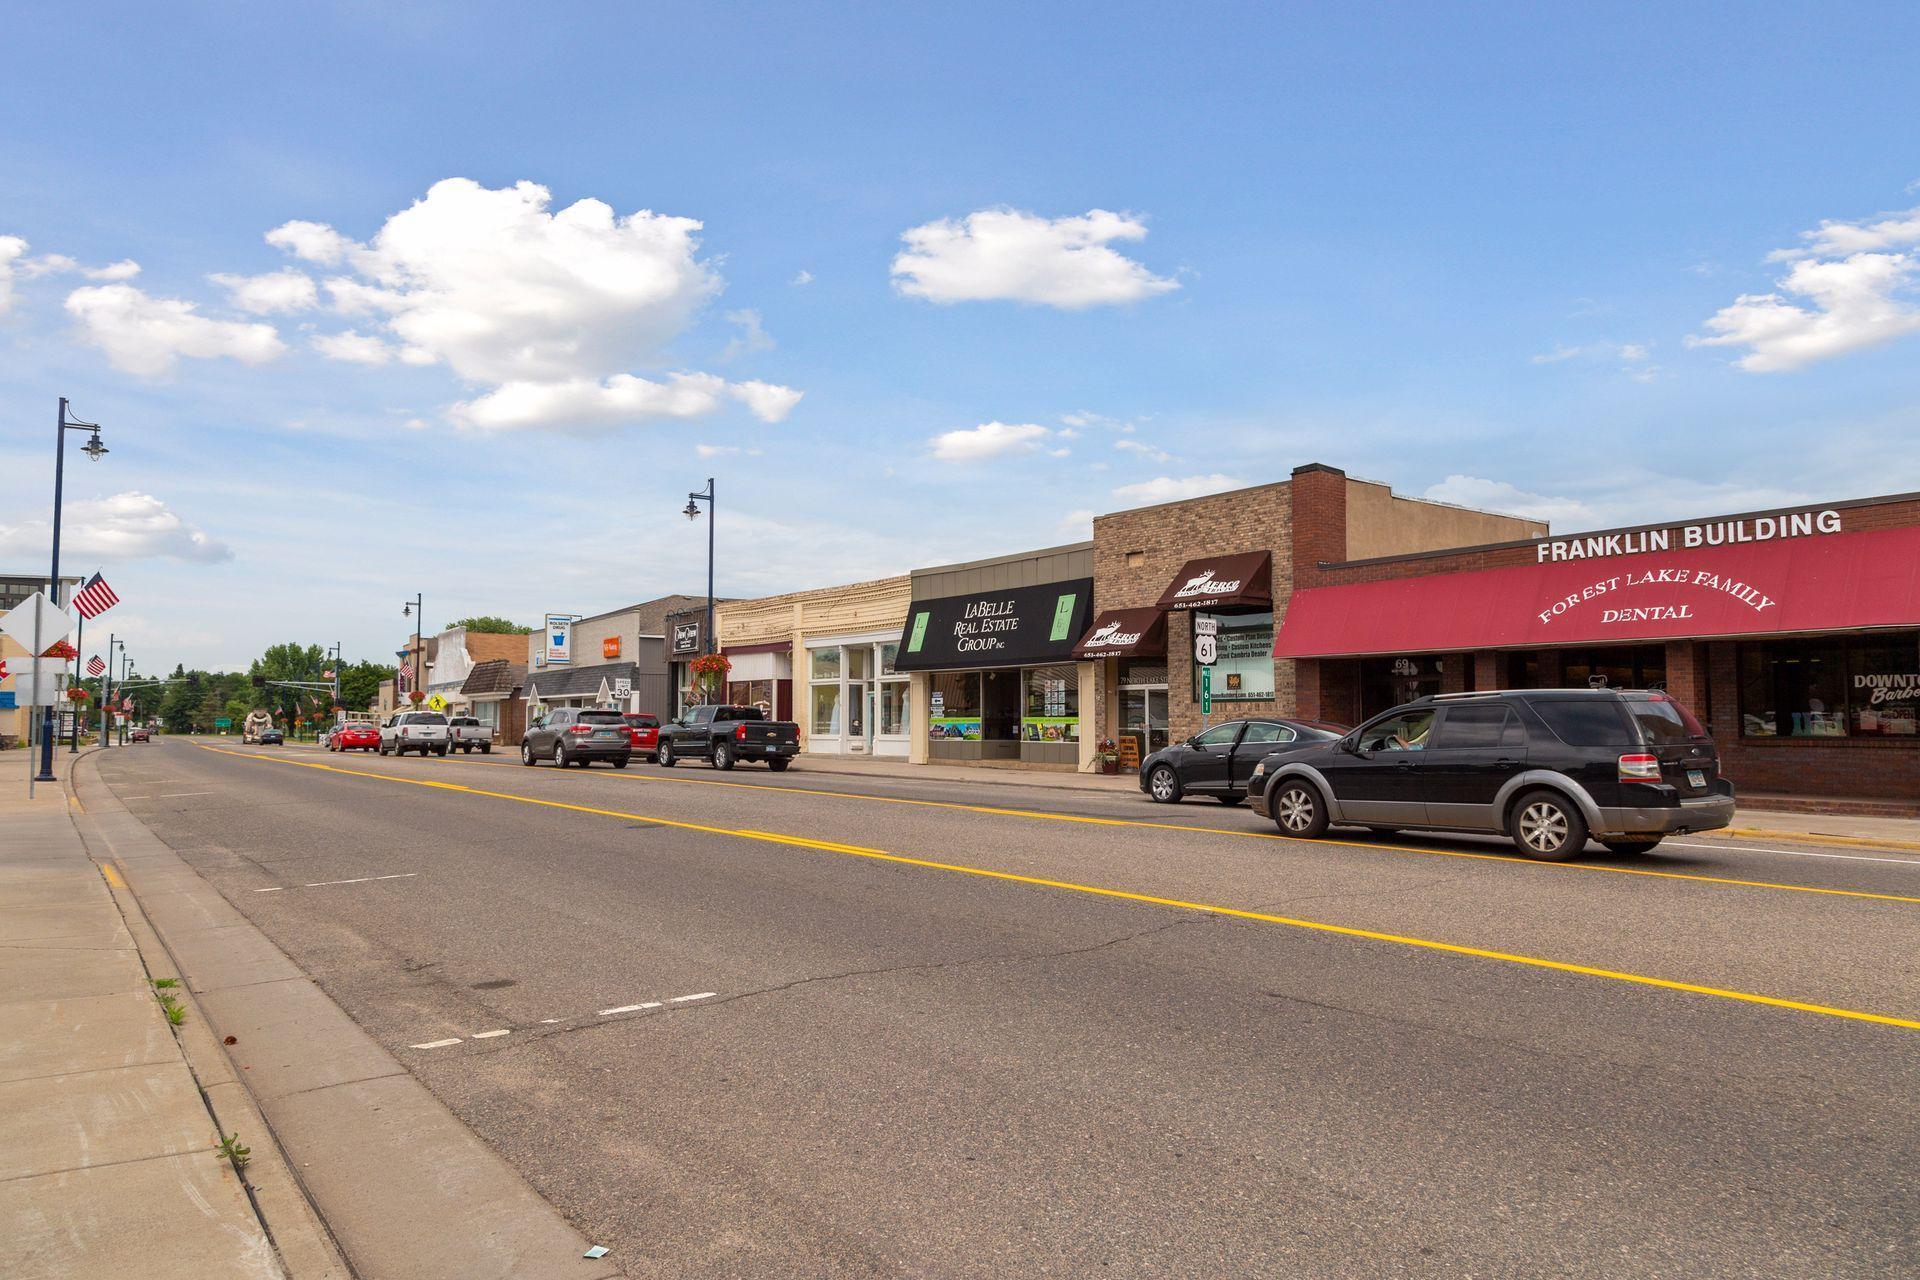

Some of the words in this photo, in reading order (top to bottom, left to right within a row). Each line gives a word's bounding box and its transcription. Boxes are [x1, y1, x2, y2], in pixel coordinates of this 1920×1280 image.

[1537, 530, 1669, 563] FRANKLIN
[1684, 510, 1842, 548] BUILDING
[1538, 577, 1621, 624] FOREST
[1626, 569, 1690, 586] LAKE
[1692, 571, 1776, 613] FAMILY
[1601, 604, 1694, 623] DENTAL
[953, 621, 979, 637] REAL
[981, 617, 1020, 633] ESTATE
[1197, 622, 1216, 631] NORTH
[957, 637, 997, 652] GROUP
[1201, 644, 1212, 657] 61
[1395, 659, 1409, 669] 69
[1854, 674, 1920, 688] DOWNT
[616, 688, 630, 697] 30
